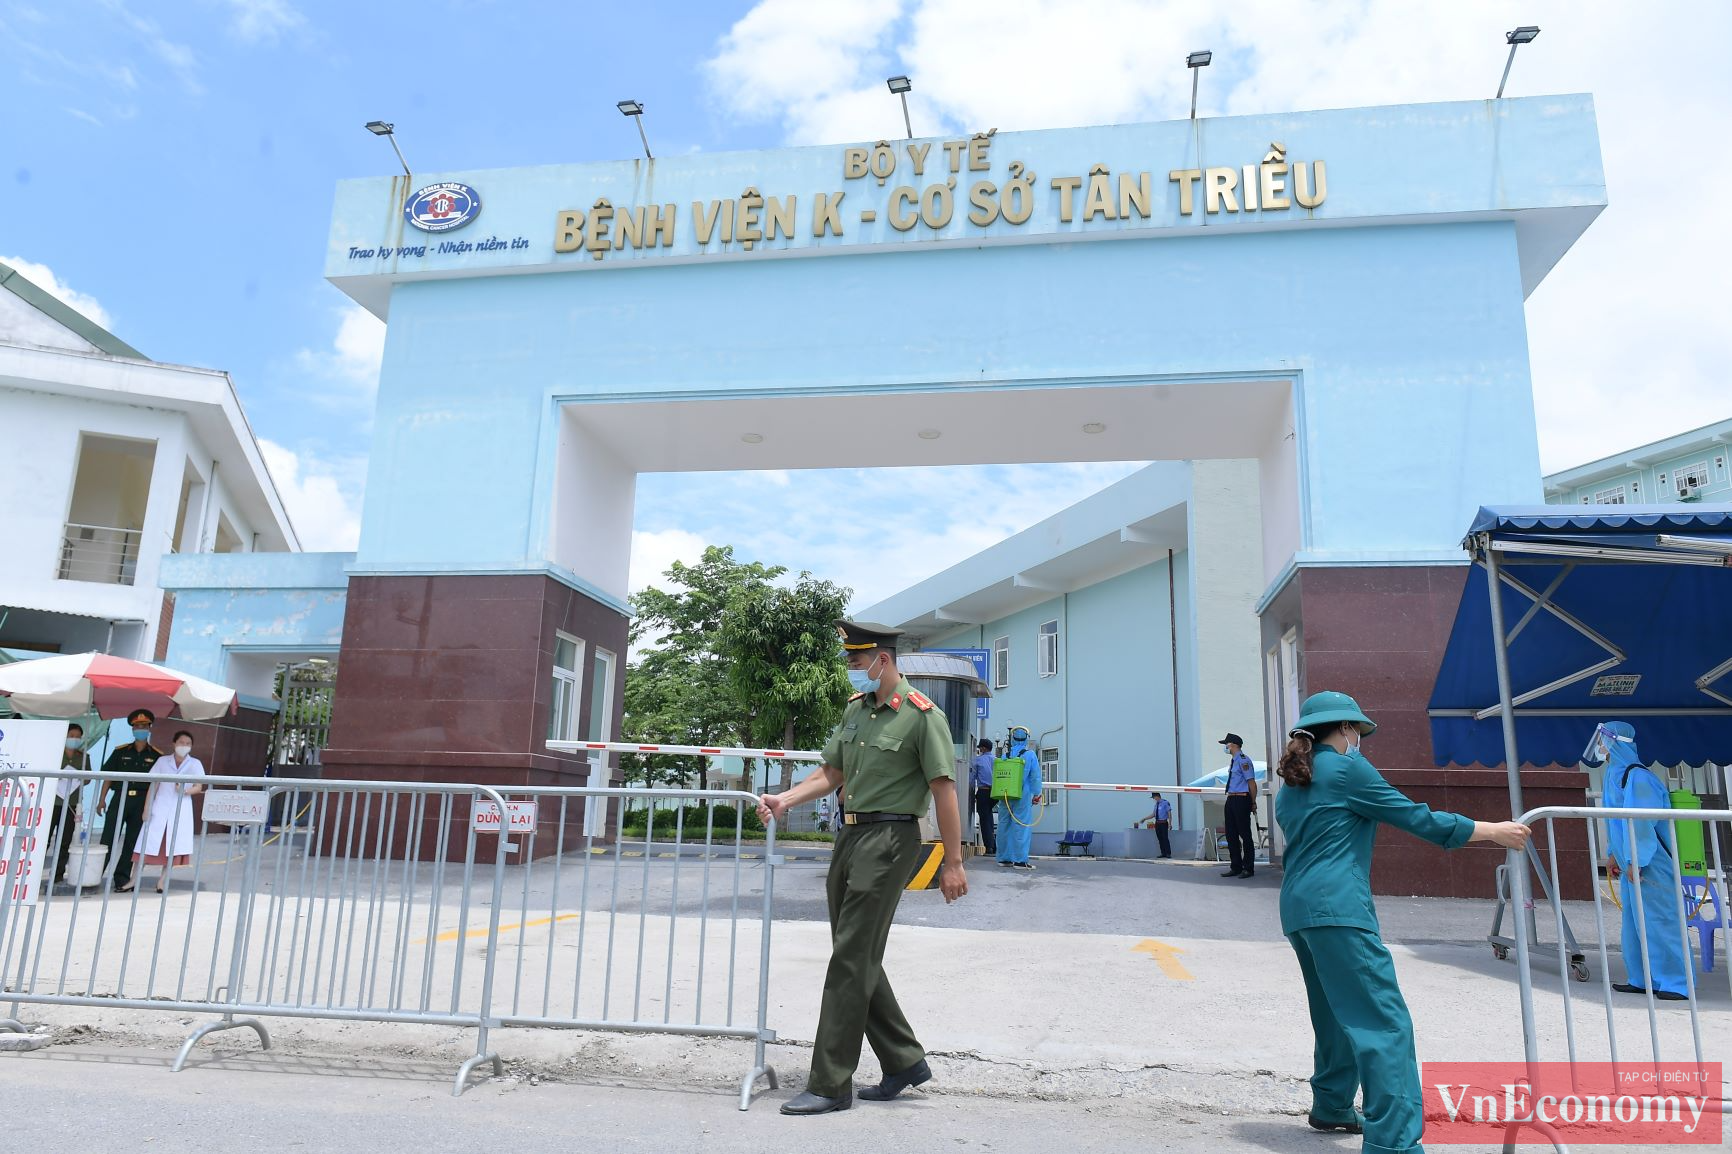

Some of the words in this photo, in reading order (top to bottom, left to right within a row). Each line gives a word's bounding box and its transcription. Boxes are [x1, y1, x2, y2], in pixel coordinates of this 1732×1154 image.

[845, 140, 896, 187] BỘ
[907, 143, 932, 176] Y
[943, 128, 998, 172] TẾ
[555, 197, 676, 261] BỆNH
[692, 187, 797, 252] VIỆN
[813, 192, 846, 238] K
[861, 210, 876, 223] -
[888, 176, 957, 232] CƠ
[968, 160, 1037, 227] SỞ
[1051, 163, 1152, 223] TÂN
[1168, 141, 1328, 216] TRIỀU
[349, 247, 375, 260] Trao
[377, 247, 393, 260] hy
[396, 245, 427, 259] vọng
[438, 240, 474, 256] Nhận
[475, 236, 508, 252] niềm
[477, 811, 504, 824] DỪN
[511, 814, 531, 827] LẠI
